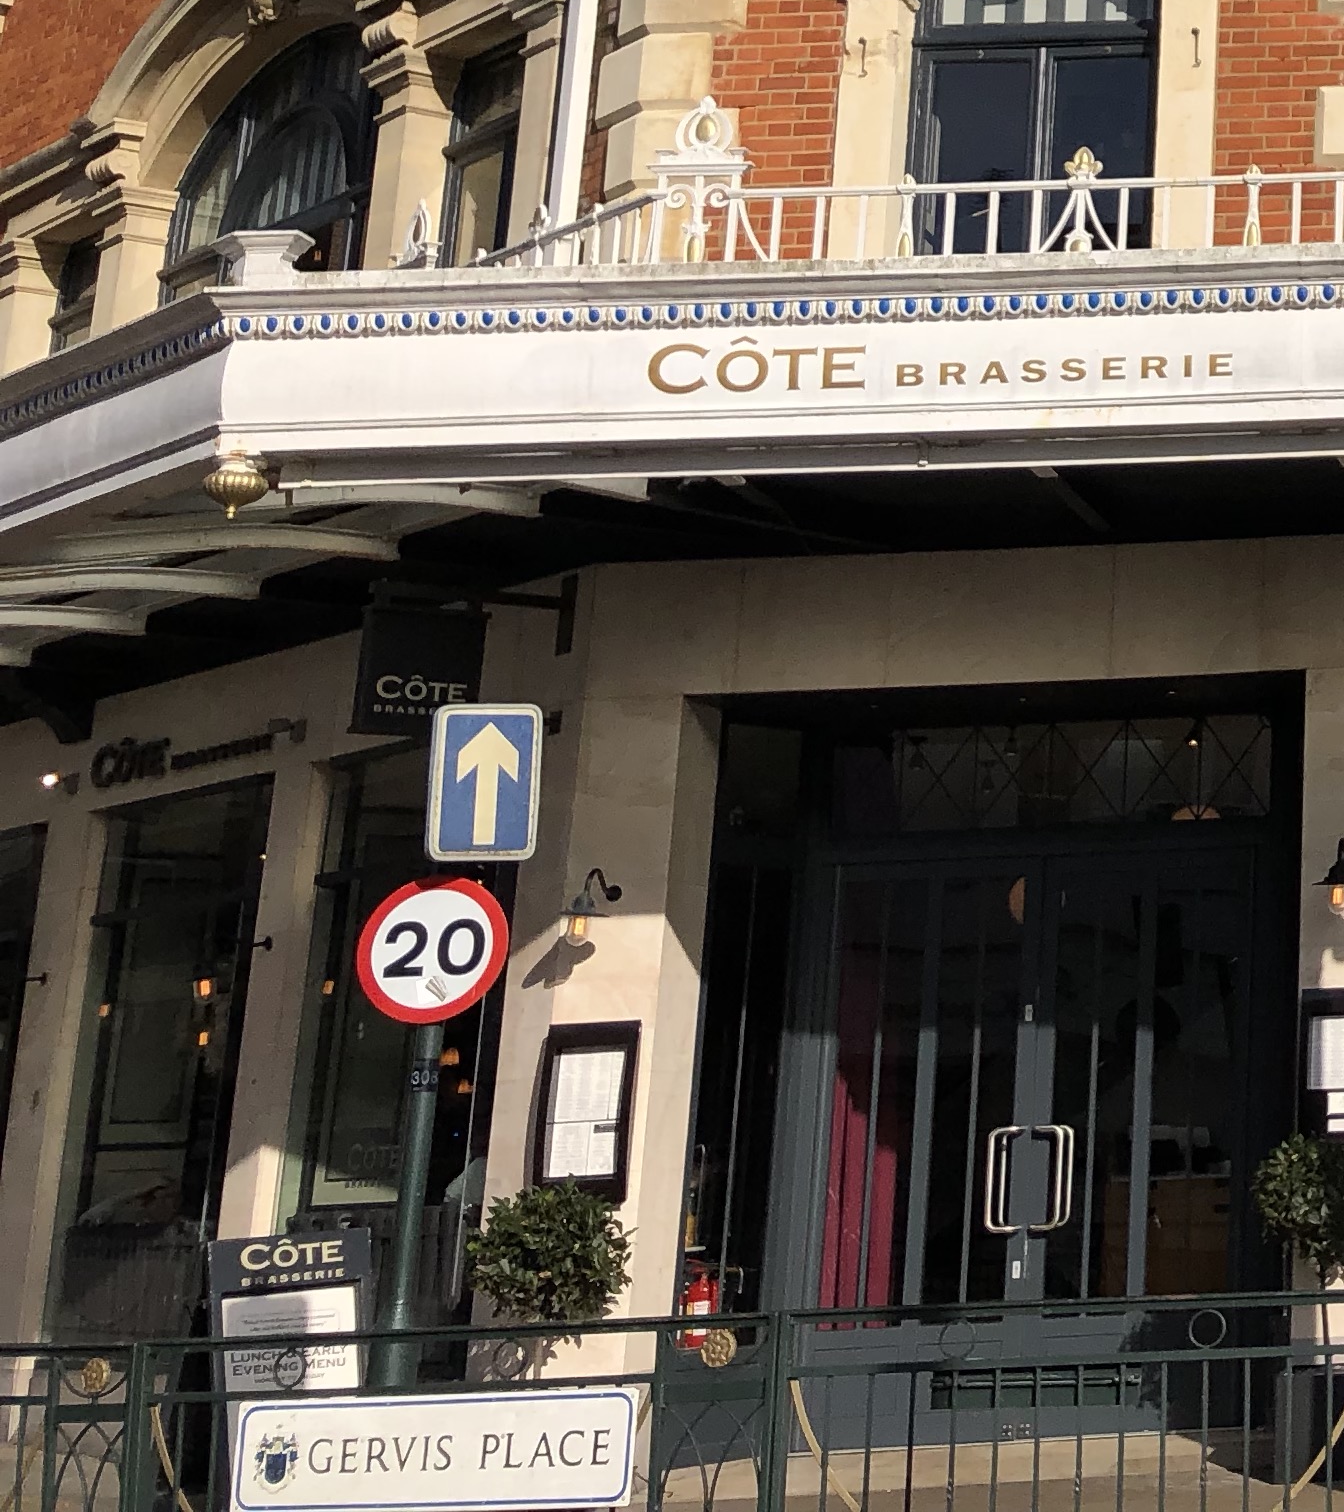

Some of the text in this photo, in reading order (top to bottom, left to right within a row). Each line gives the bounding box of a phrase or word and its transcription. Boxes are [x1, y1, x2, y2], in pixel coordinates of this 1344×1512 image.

[648, 336, 1234, 395] CÔTE BRASSERIE
[376, 674, 468, 703] CÔTE
[383, 918, 486, 978] 20
[240, 1239, 344, 1270] CÔTE
[241, 1268, 346, 1287] BRASSERIE
[231, 1350, 280, 1364] LUNCH
[308, 1428, 612, 1475] GERVIS PLACE
